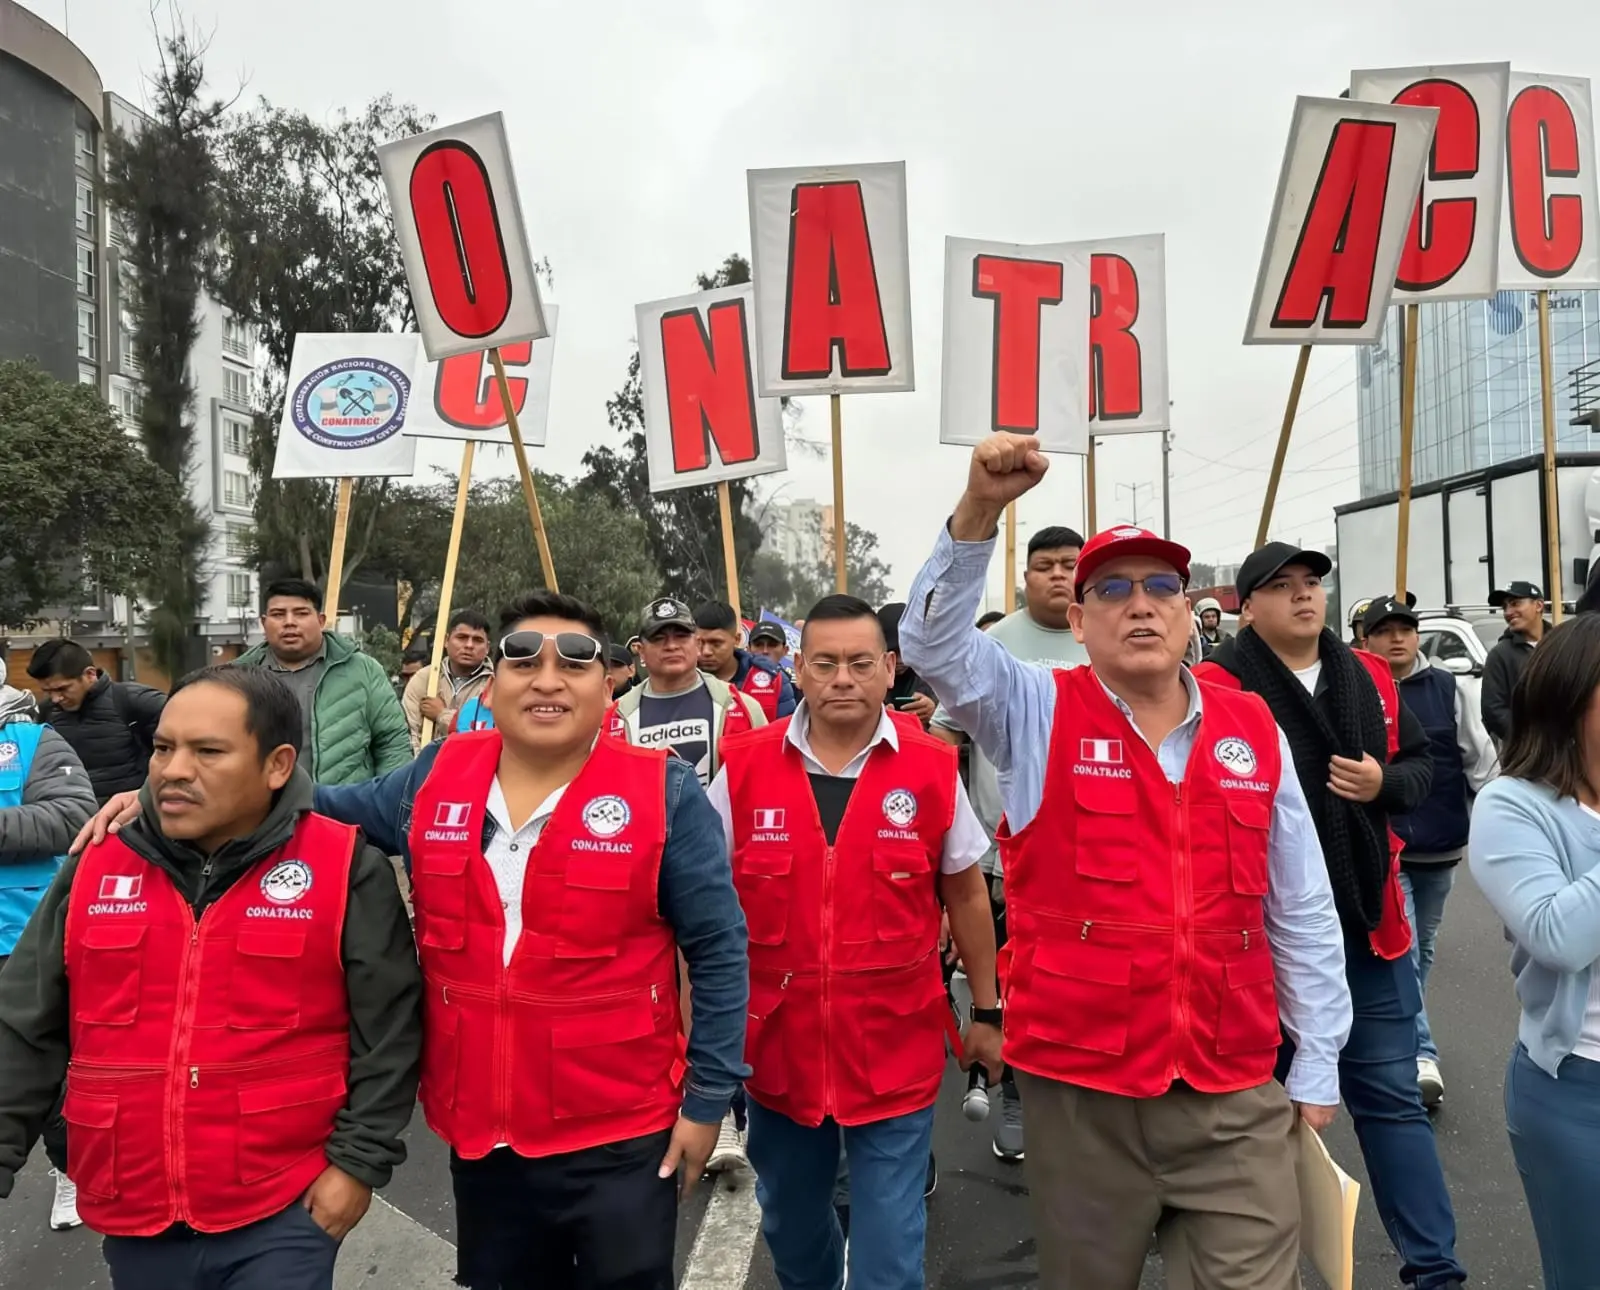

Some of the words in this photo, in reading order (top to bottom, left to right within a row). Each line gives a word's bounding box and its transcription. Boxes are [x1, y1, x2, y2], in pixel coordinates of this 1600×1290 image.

[1391, 78, 1480, 292] C
[1506, 85, 1583, 278] C
[1270, 118, 1397, 329] A
[410, 139, 512, 338] O
[781, 180, 892, 380] A
[973, 254, 1064, 434] T
[661, 298, 760, 474] N
[321, 417, 380, 426] CONATRACC
[376, 424, 398, 440] CIVIL
[639, 724, 703, 744] adidas
[1073, 764, 1132, 779] CONATRACC
[1220, 779, 1271, 792] CONATRACC
[424, 830, 470, 841] CONATRACC
[571, 839, 633, 854] CONATRACC
[88, 901, 147, 915] CONATRACC
[246, 906, 313, 919] CONATRACC
